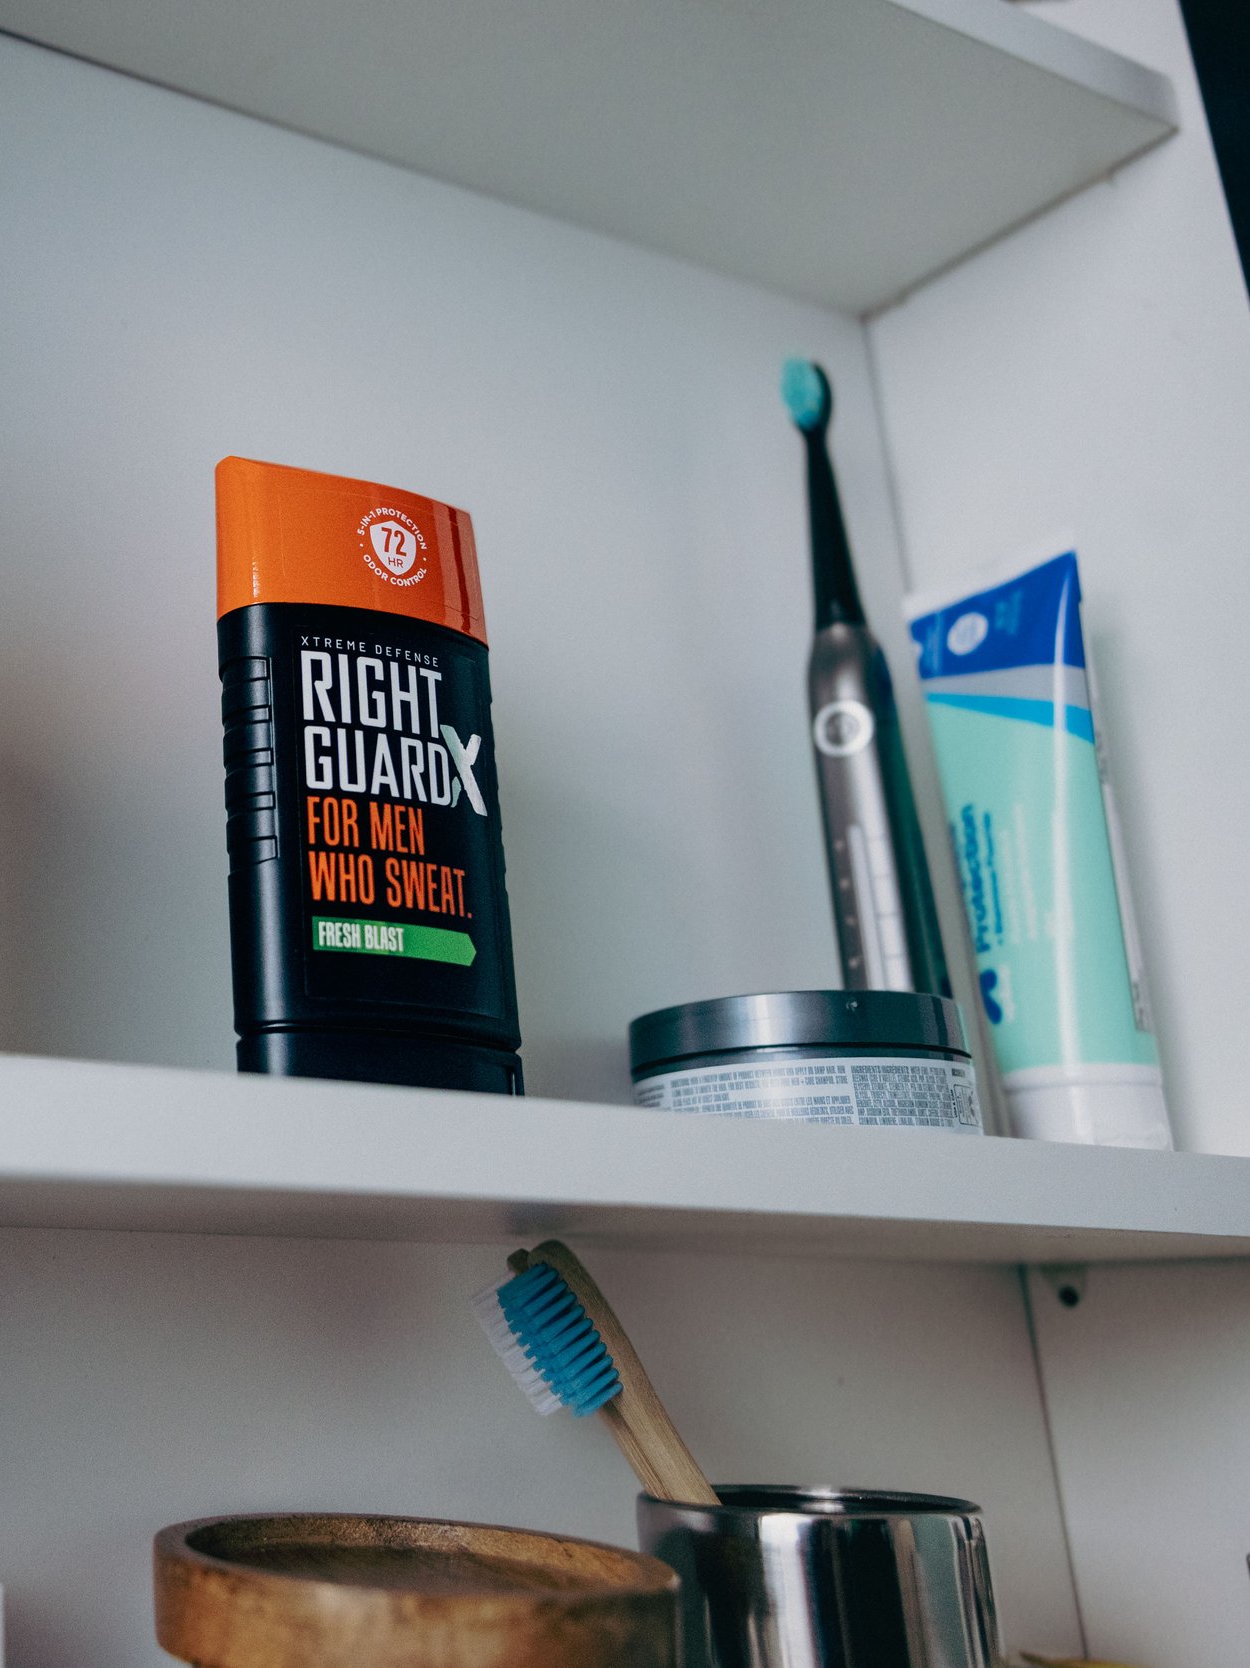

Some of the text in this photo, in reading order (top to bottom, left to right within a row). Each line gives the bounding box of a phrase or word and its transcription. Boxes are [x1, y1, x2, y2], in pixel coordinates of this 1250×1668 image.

[357, 508, 427, 549] 5-IN-1 PROTECTION
[381, 527, 407, 557] 72
[363, 554, 426, 586] ODOR CONTROL
[388, 557, 403, 568] HR
[301, 636, 439, 667] XTREME DEFENSE
[301, 650, 442, 738] RIGHT
[307, 796, 425, 855] FOR MEN
[308, 851, 472, 918] WHO SWEAT.
[318, 922, 404, 951] FRESH BLAST
